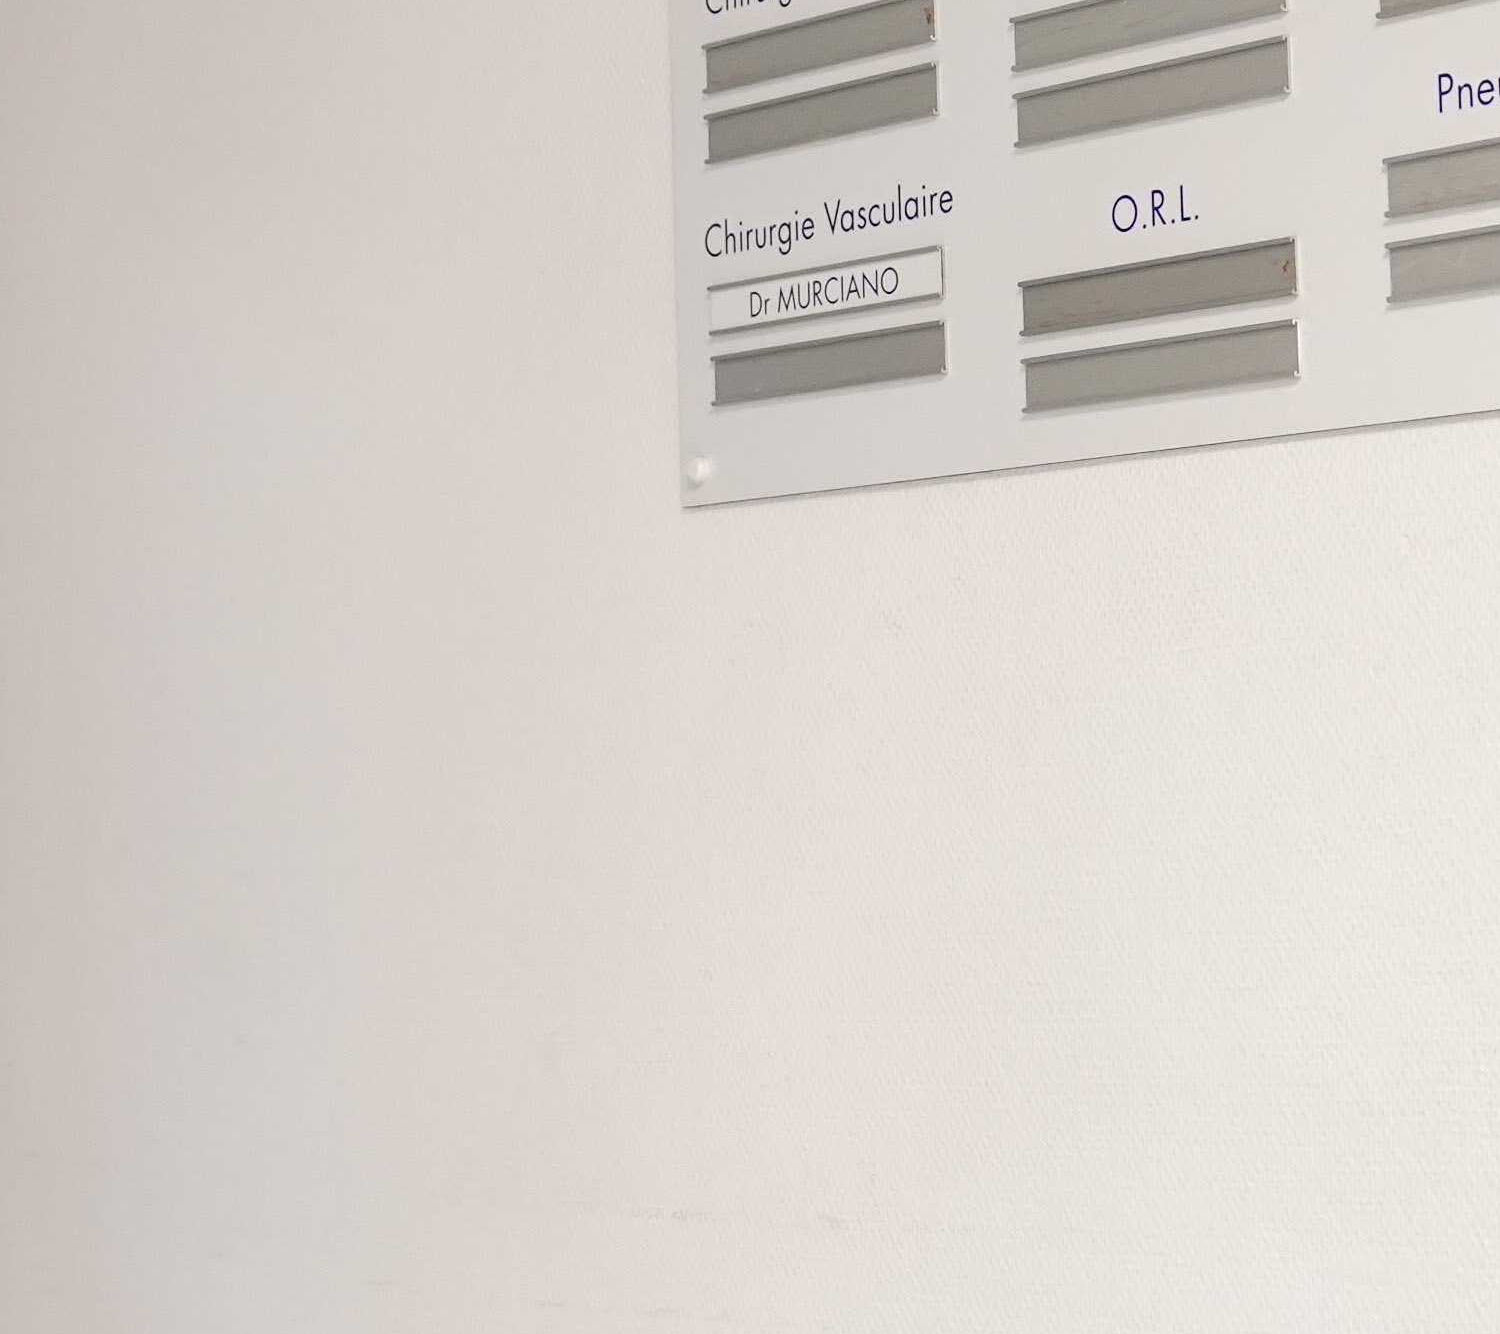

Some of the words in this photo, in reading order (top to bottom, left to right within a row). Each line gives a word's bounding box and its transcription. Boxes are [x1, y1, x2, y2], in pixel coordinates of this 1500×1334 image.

[704, 210, 815, 257] Chirurgie
[823, 183, 953, 235] Vasculaire
[1112, 184, 1199, 233] O.R.L.
[749, 291, 770, 318] Dr
[777, 266, 899, 313] MURCIANO
